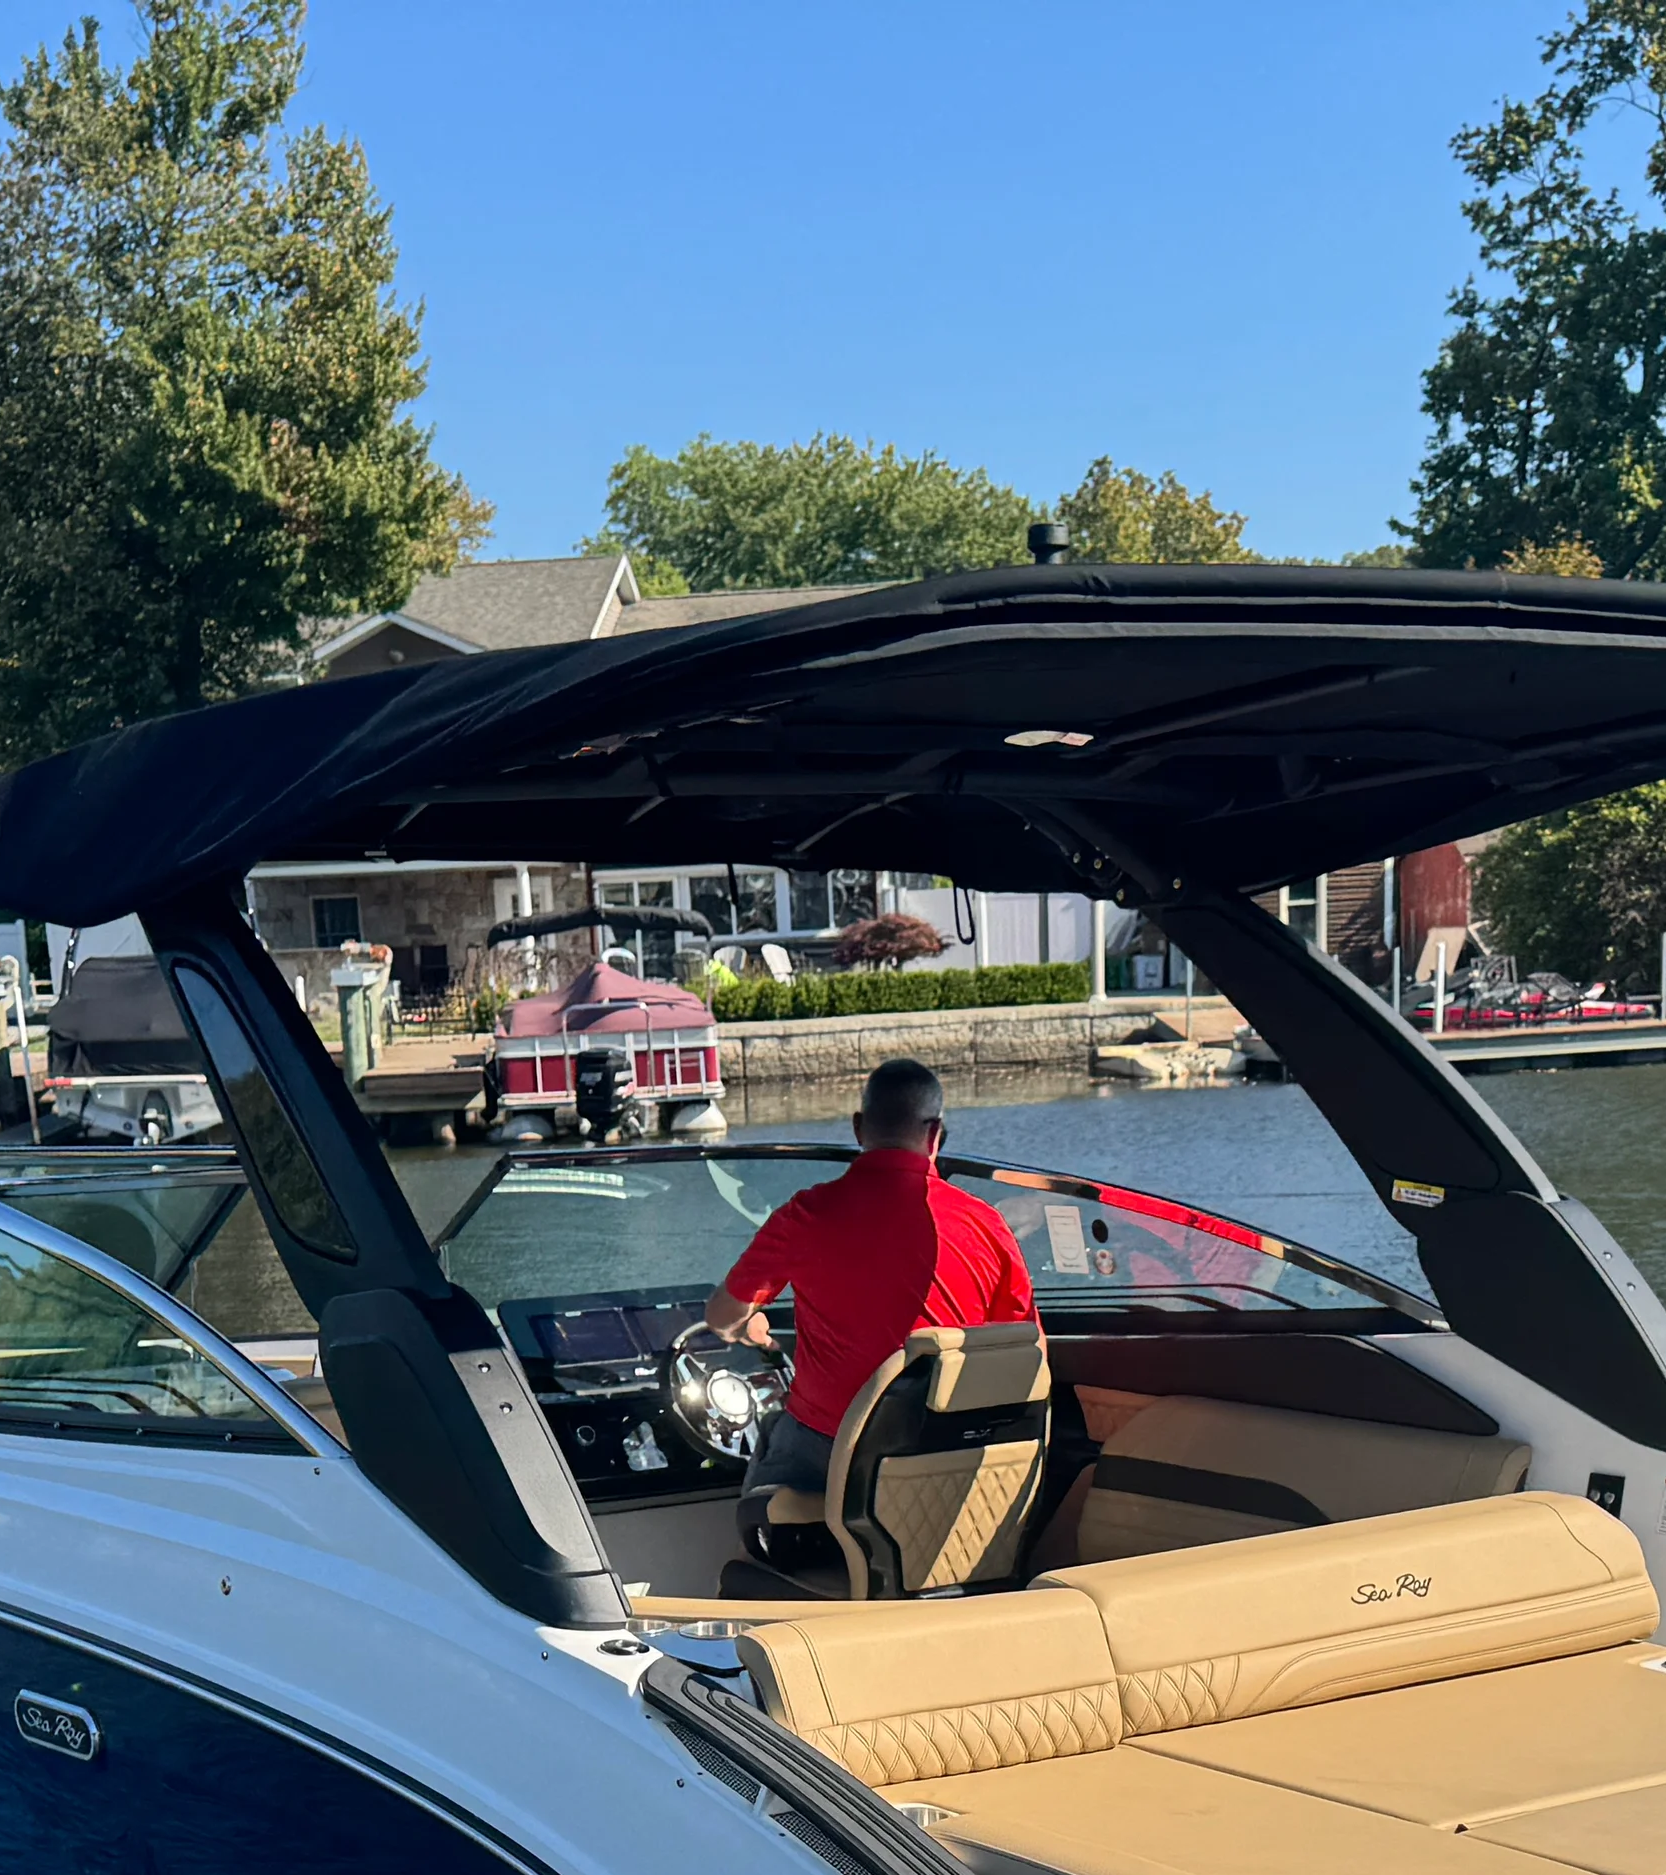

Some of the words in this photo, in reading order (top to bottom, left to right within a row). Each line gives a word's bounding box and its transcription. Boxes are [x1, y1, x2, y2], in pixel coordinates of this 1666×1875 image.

[1350, 1583, 1393, 1605] Sea
[1395, 1573, 1432, 1597] Ray
[22, 1707, 51, 1733] Sea
[53, 1714, 86, 1750] Ray
